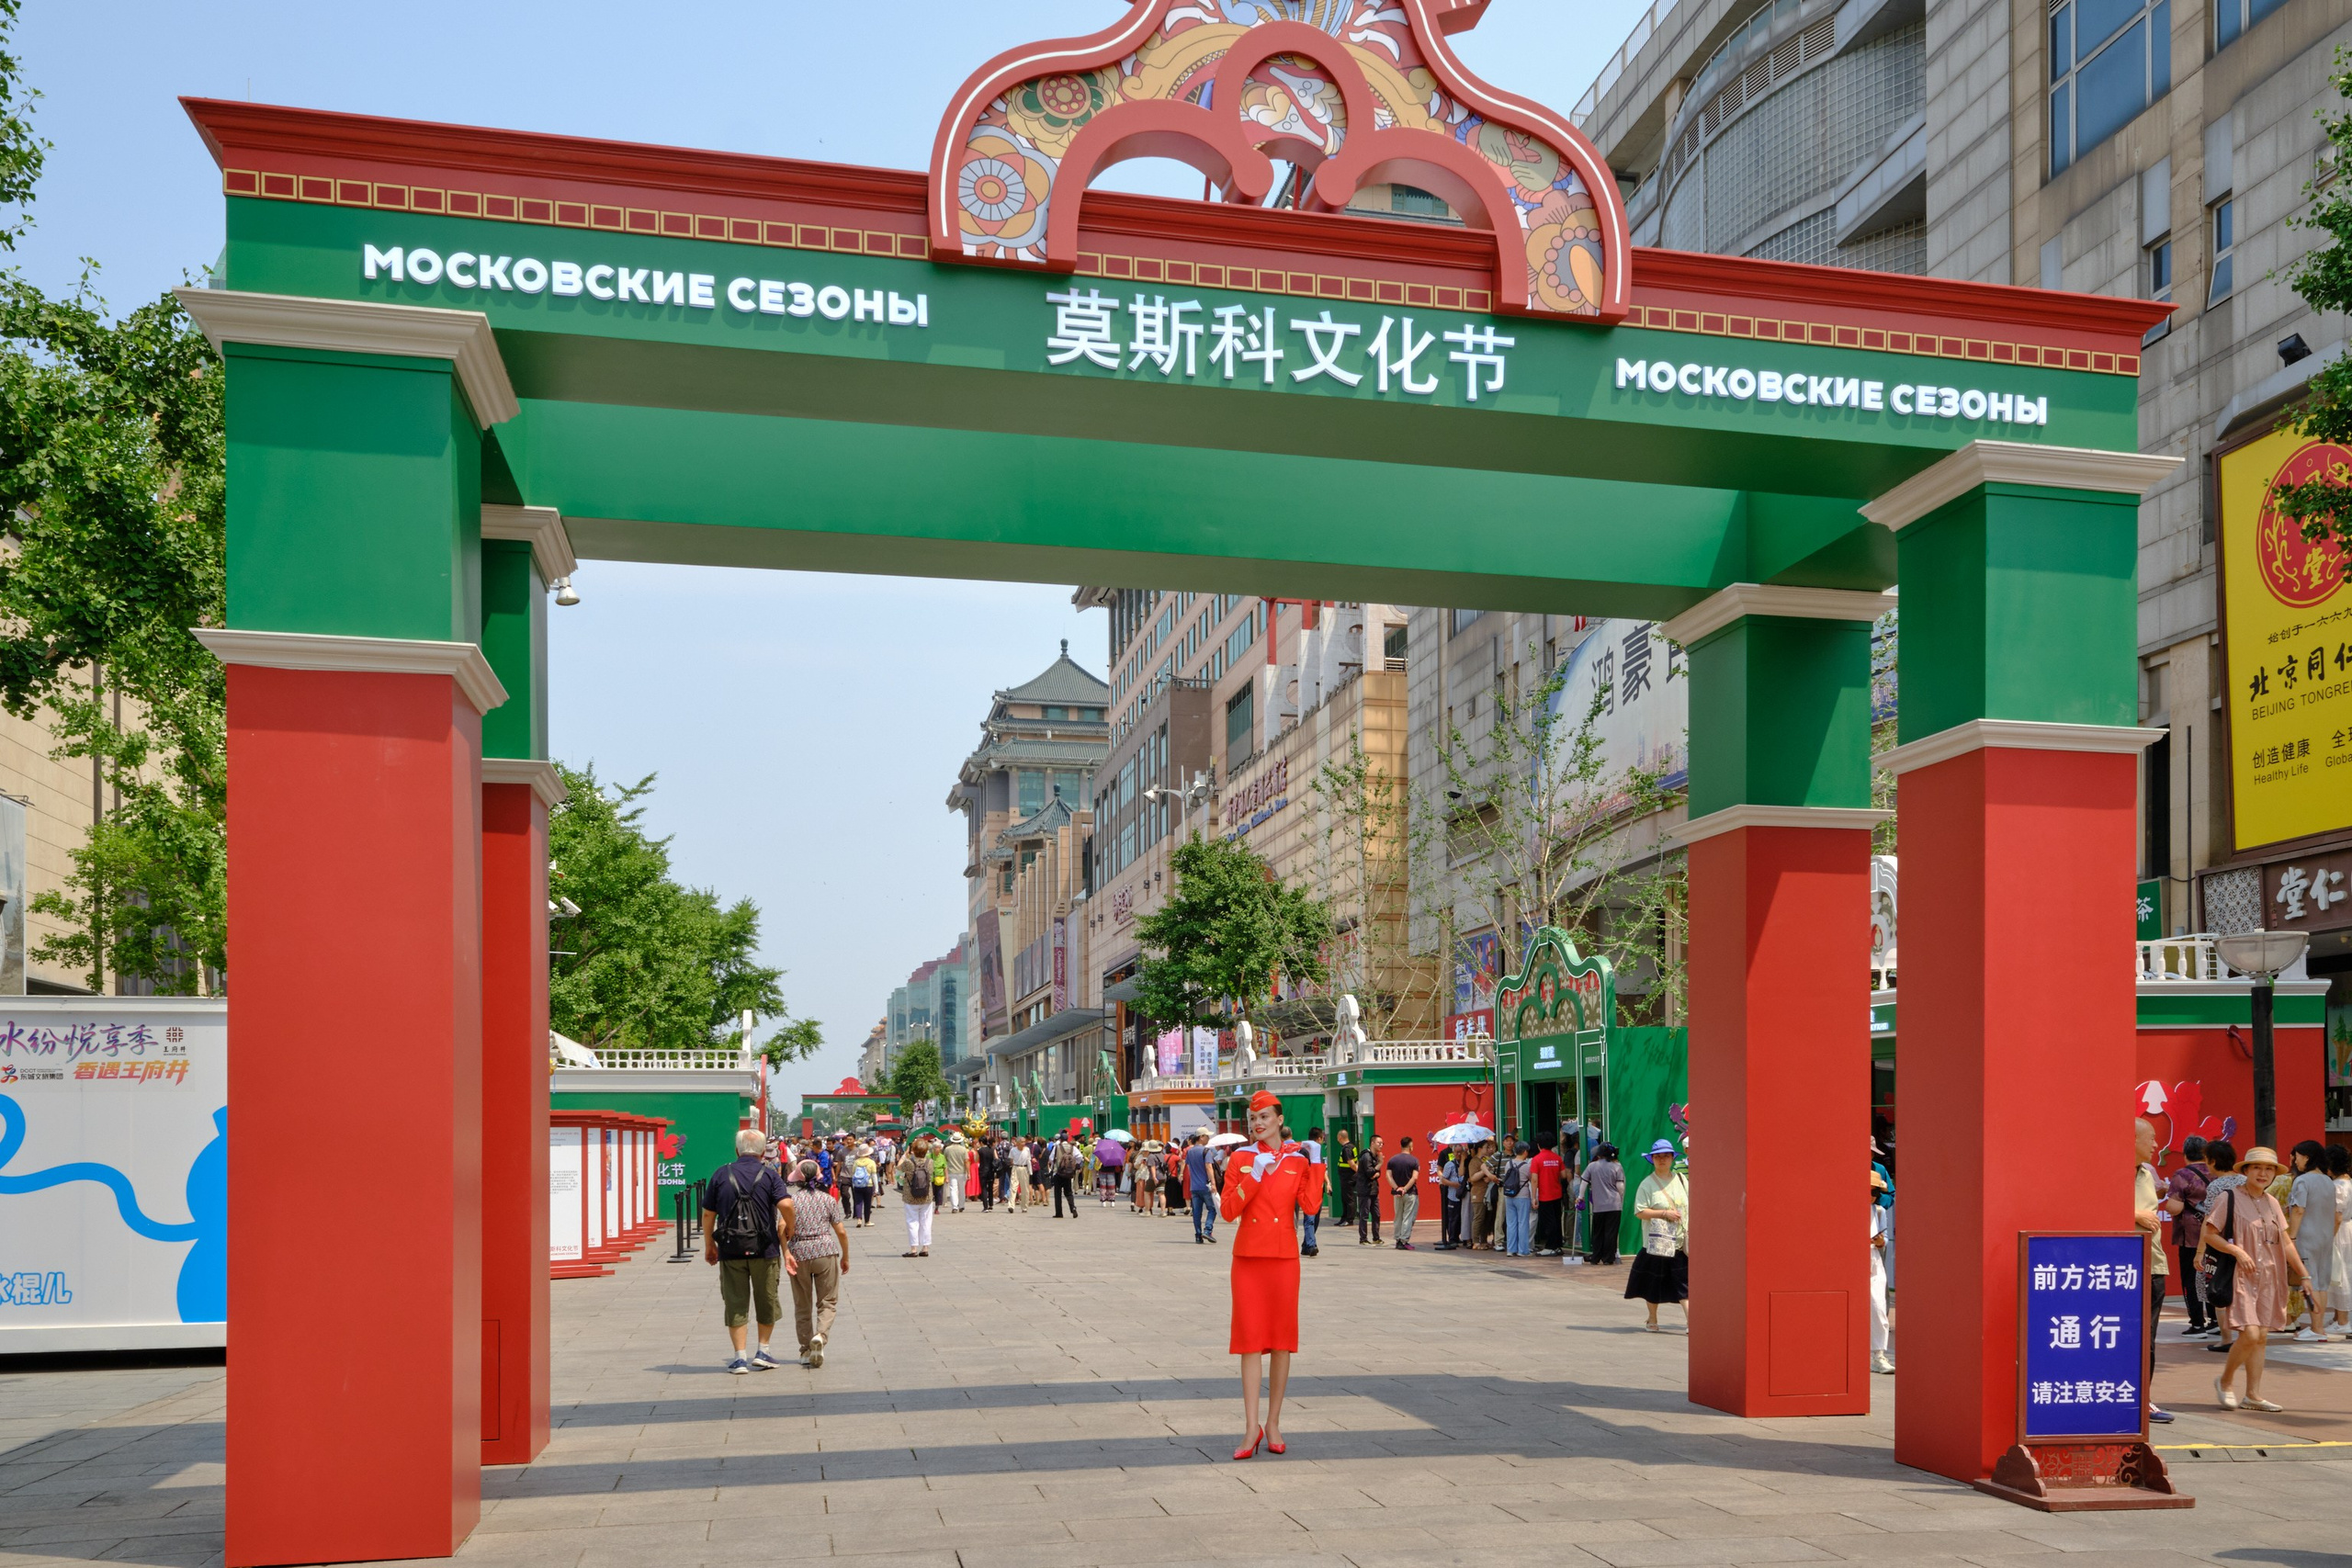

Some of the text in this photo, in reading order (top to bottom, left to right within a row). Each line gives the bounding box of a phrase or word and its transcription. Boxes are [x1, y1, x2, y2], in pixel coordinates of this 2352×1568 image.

[363, 243, 928, 328] МОСКОВСКИЕ СЕЗОНЫ
[1046, 288, 1515, 401] 莫斯科文化节
[1615, 357, 2048, 426] МОСКОВСКИЕ СЕЗОНЫ
[2252, 698, 2295, 721] BEIJING
[2253, 738, 2311, 769] 创造健康
[2254, 768, 2289, 785] Healthy
[2291, 763, 2309, 777] Life
[73, 1059, 190, 1086] 香遇王府井
[2033, 1263, 2138, 1291] 前方活动
[2050, 1315, 2120, 1349] 通行
[2031, 1381, 2136, 1404] 请注意安全
